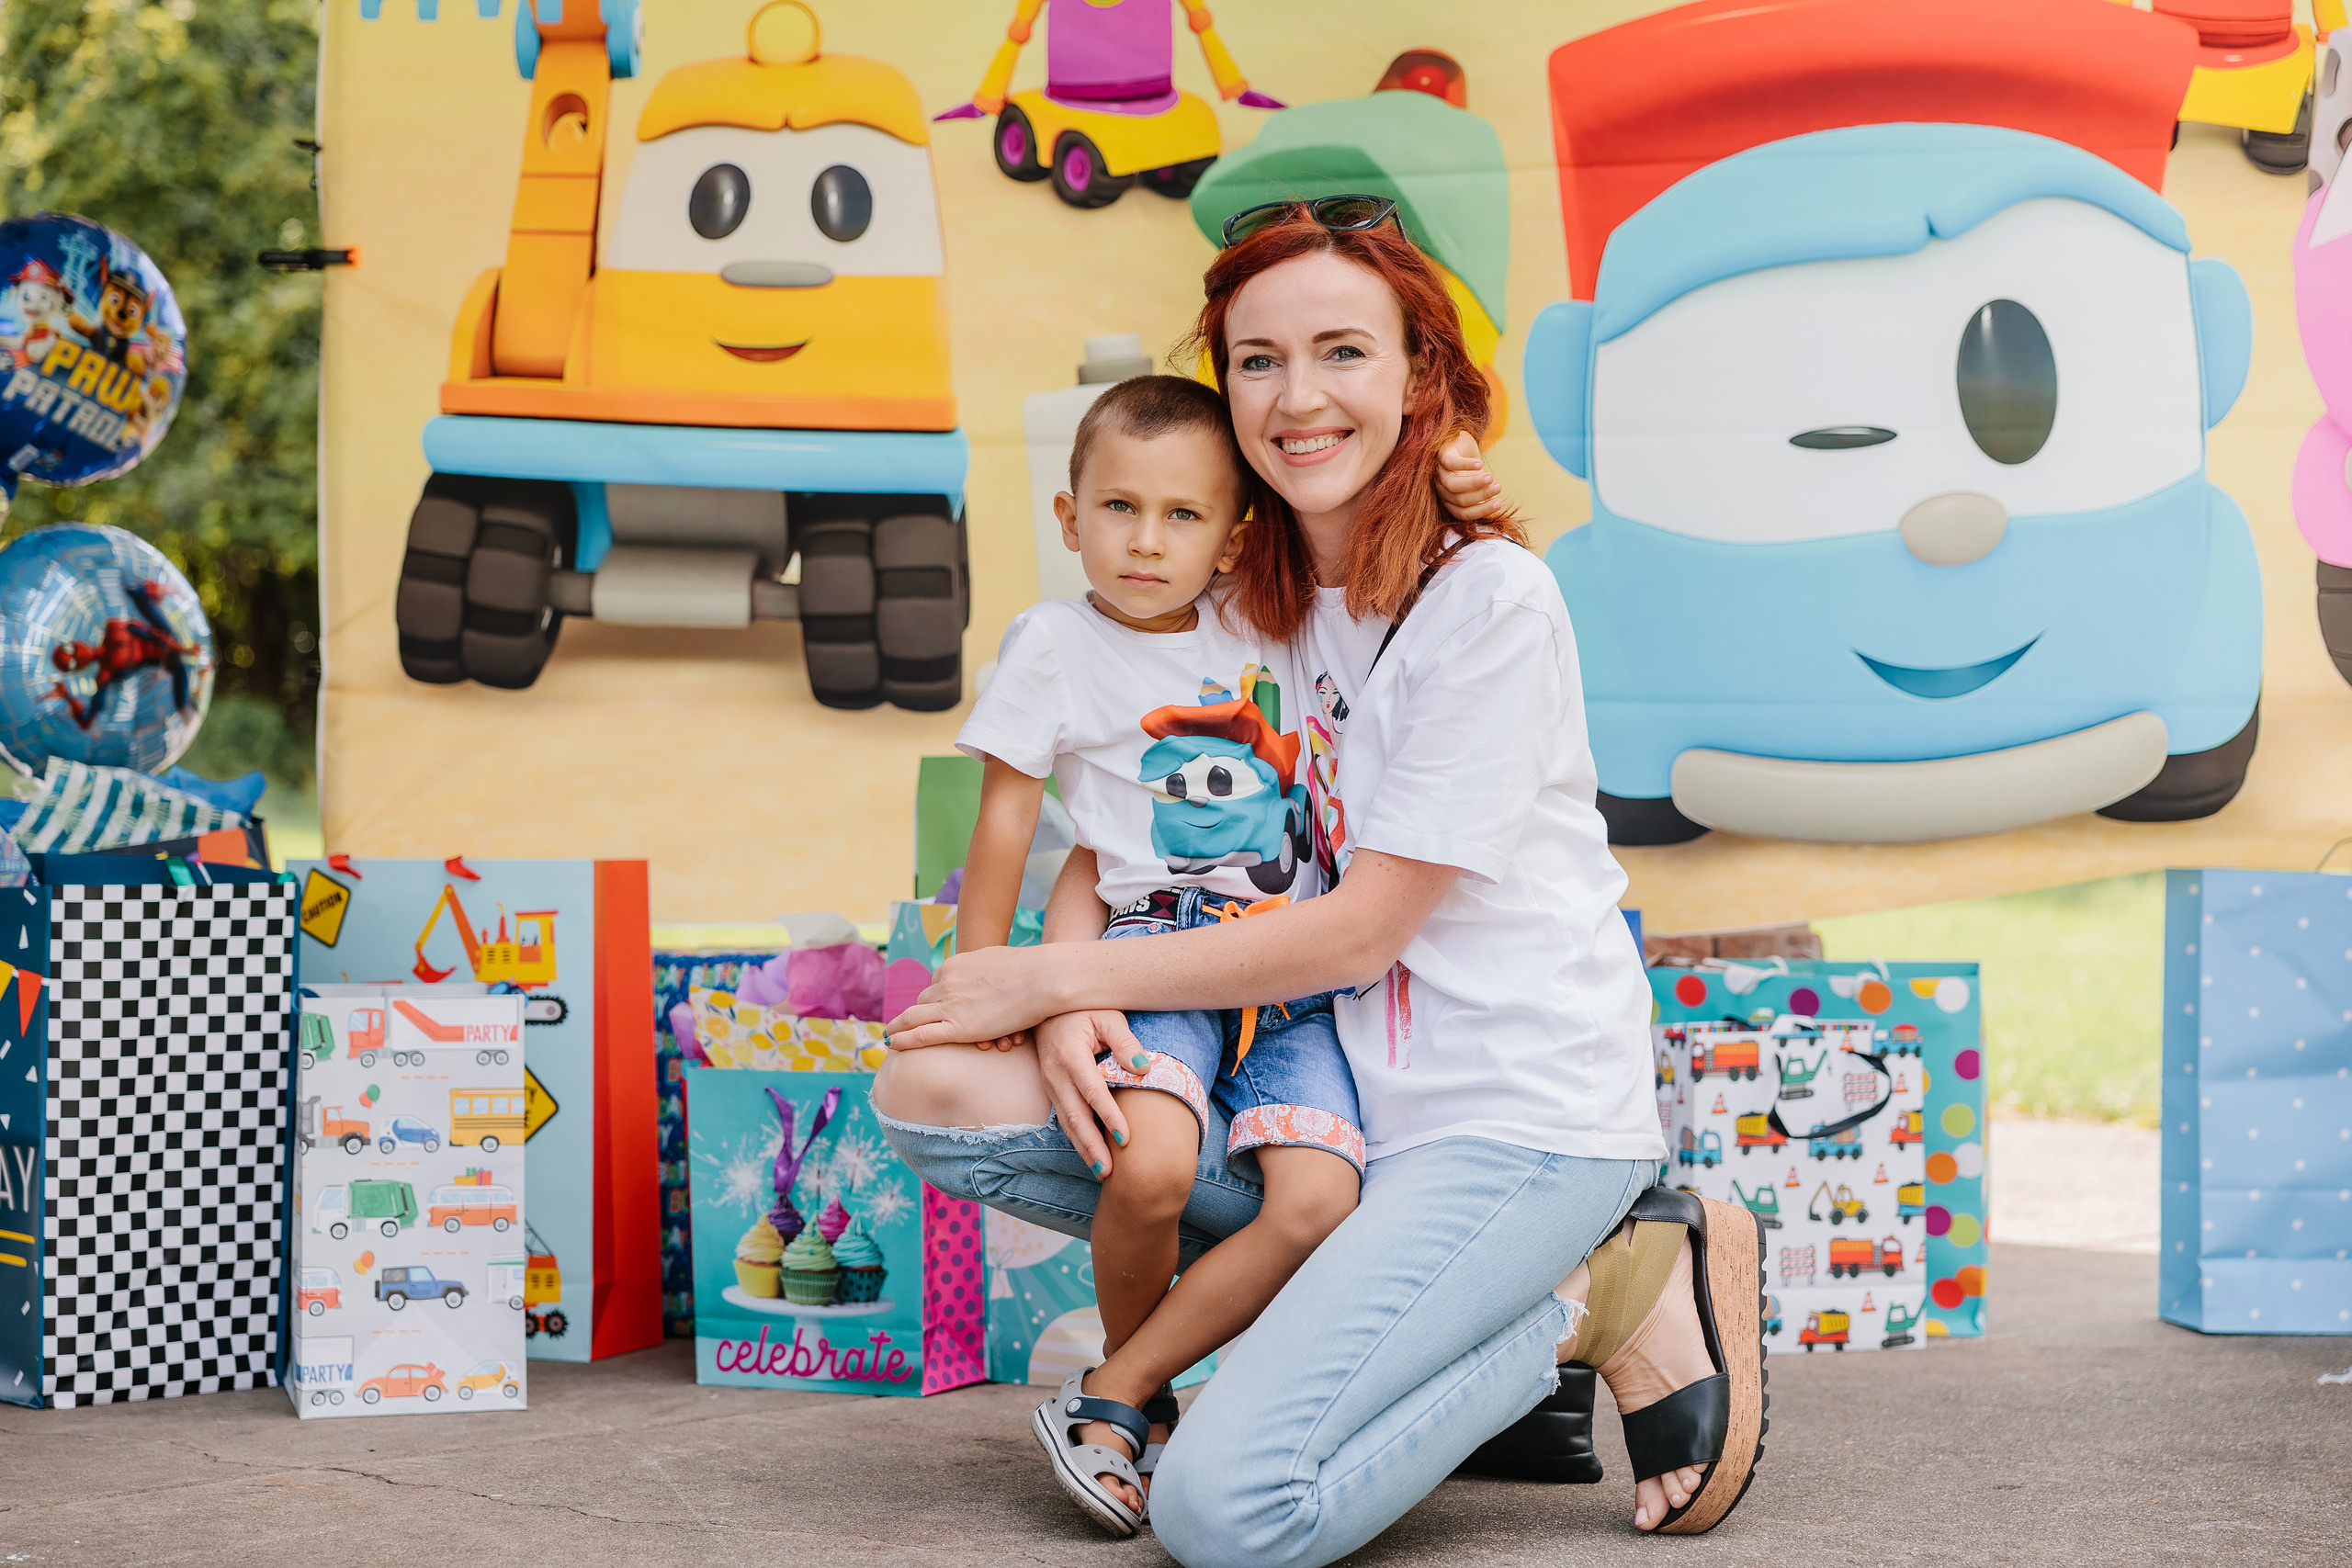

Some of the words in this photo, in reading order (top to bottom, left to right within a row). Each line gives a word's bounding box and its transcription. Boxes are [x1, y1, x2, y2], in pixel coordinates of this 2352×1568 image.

[40, 339, 141, 412] PAW
[302, 891, 343, 924] CAUTION
[467, 1024, 510, 1042] PARTY
[716, 1324, 914, 1383] celebrate
[301, 1363, 345, 1383] PARTY
